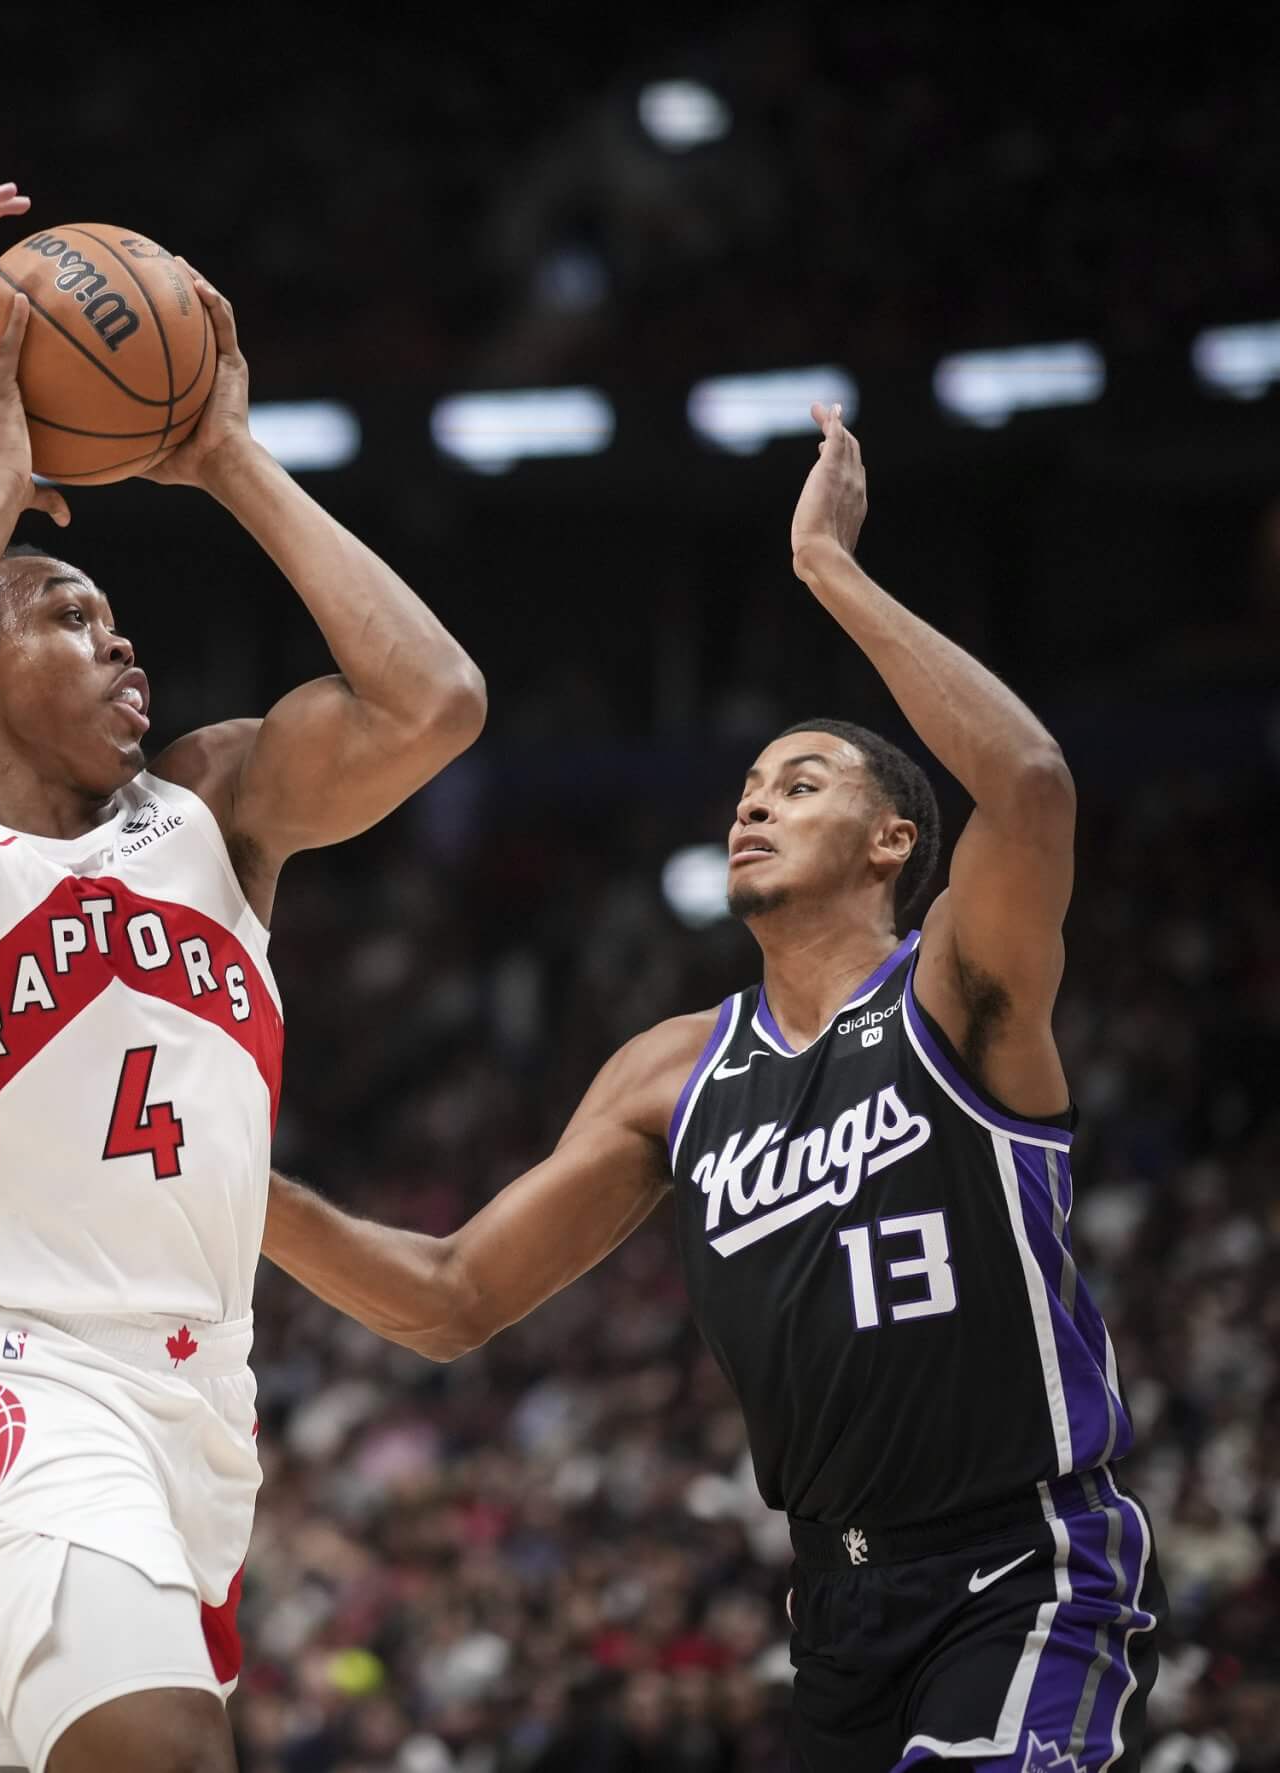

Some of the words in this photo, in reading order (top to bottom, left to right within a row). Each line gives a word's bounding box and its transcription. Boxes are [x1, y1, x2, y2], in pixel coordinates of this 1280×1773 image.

[23, 233, 140, 352] Wilson
[121, 835, 153, 857] Sun
[152, 815, 185, 838] Life
[102, 1045, 185, 1180] 4
[691, 1083, 932, 1240] Kings
[838, 1208, 958, 1330] 13
